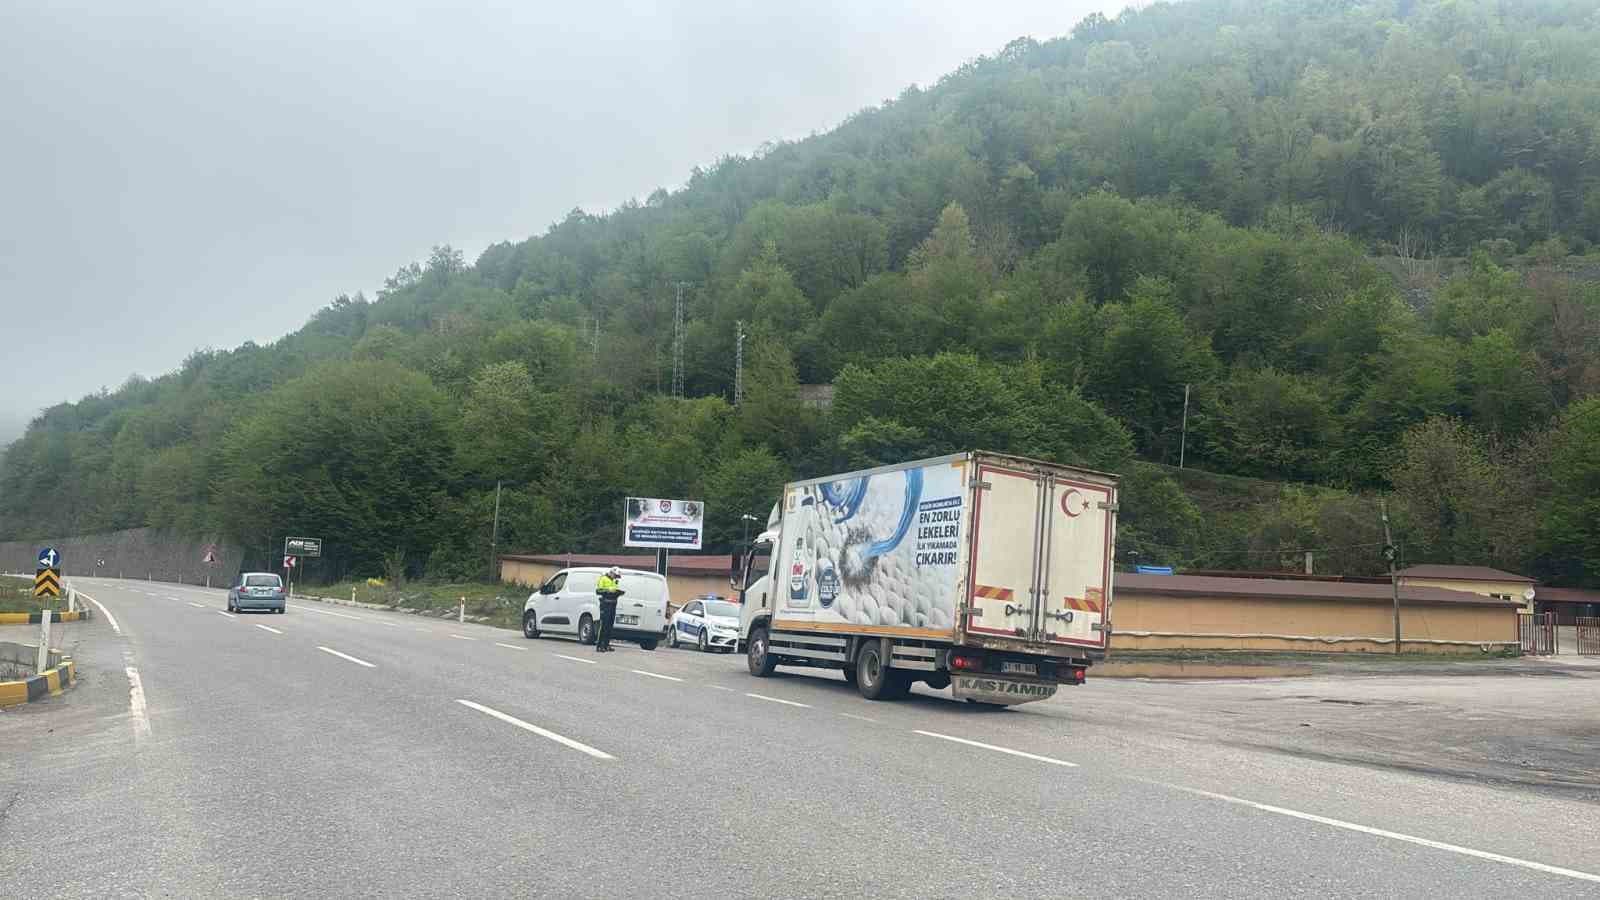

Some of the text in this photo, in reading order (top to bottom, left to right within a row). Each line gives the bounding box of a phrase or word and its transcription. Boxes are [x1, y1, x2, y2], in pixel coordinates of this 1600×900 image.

[920, 510, 960, 524] EN ZORLU
[918, 521, 960, 539] LEKELERİ
[927, 540, 957, 550] YIKAMADA
[916, 551, 957, 569] ÇIKARIR!
